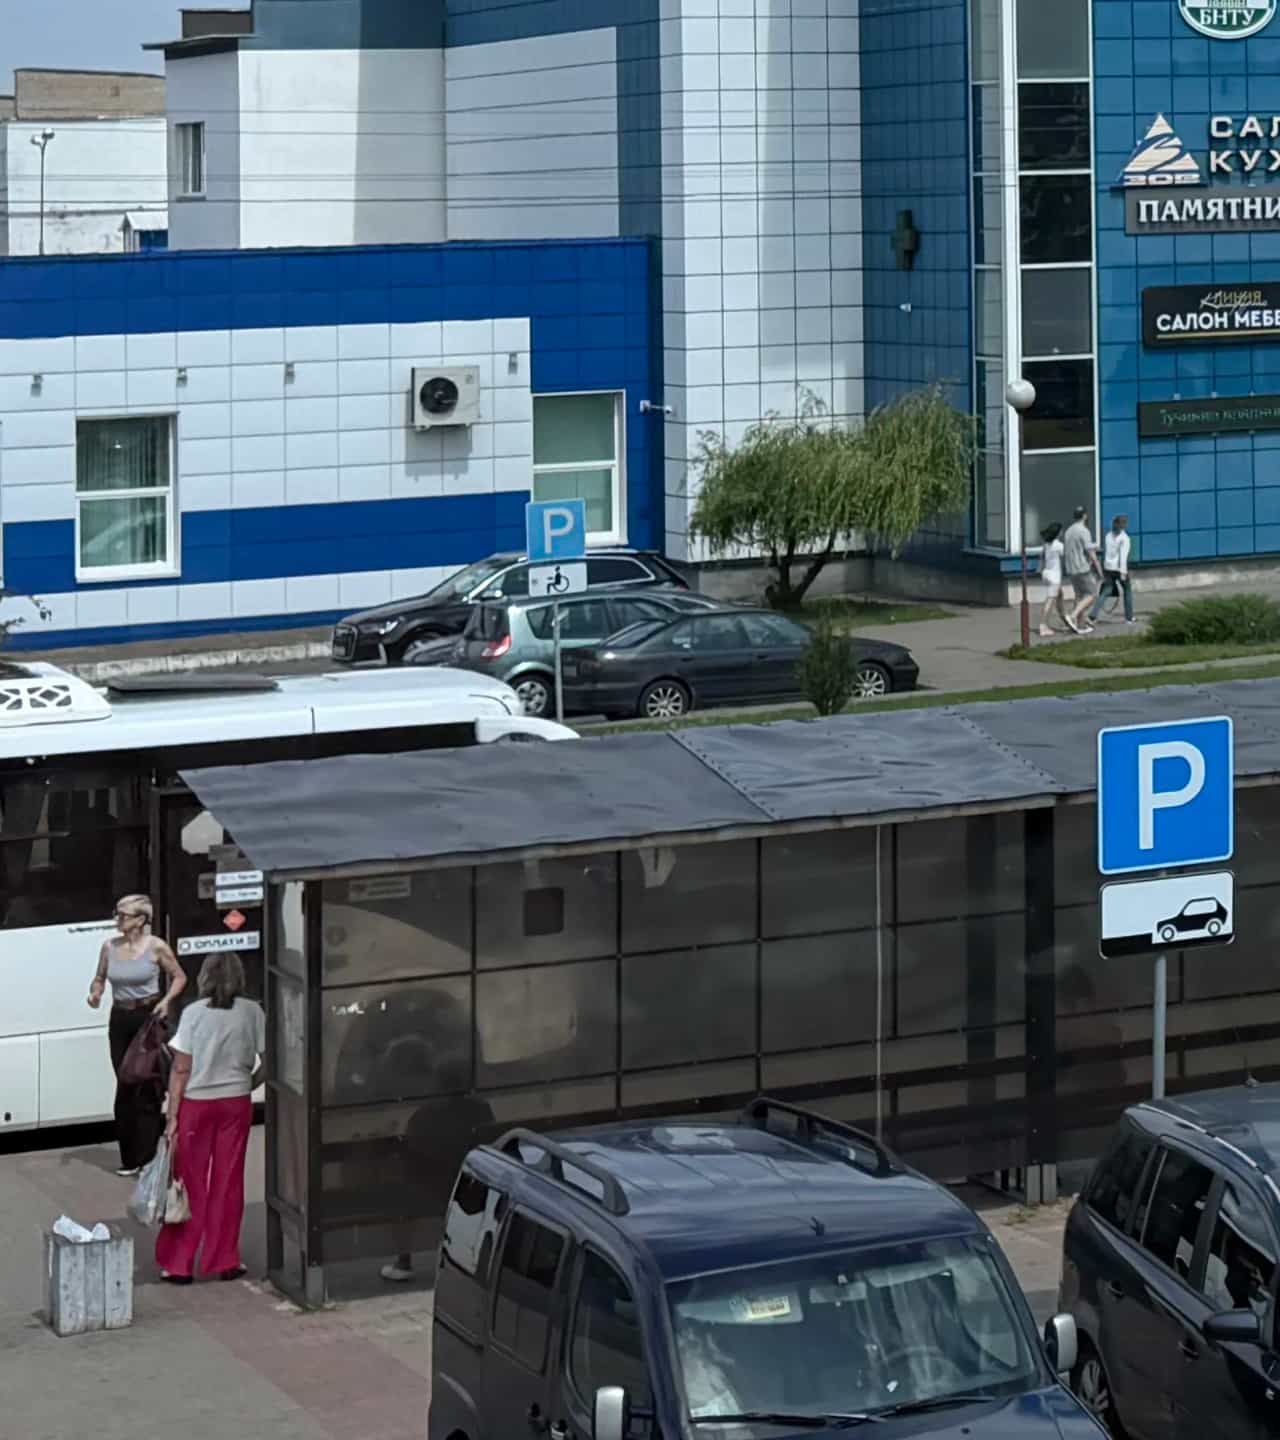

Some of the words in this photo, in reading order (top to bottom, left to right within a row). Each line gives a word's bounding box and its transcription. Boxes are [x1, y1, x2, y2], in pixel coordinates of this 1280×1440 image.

[1200, 7, 1256, 26] БНТУ
[1156, 312, 1228, 332] САЛОН
[543, 507, 575, 554] P
[1138, 740, 1206, 850] P
